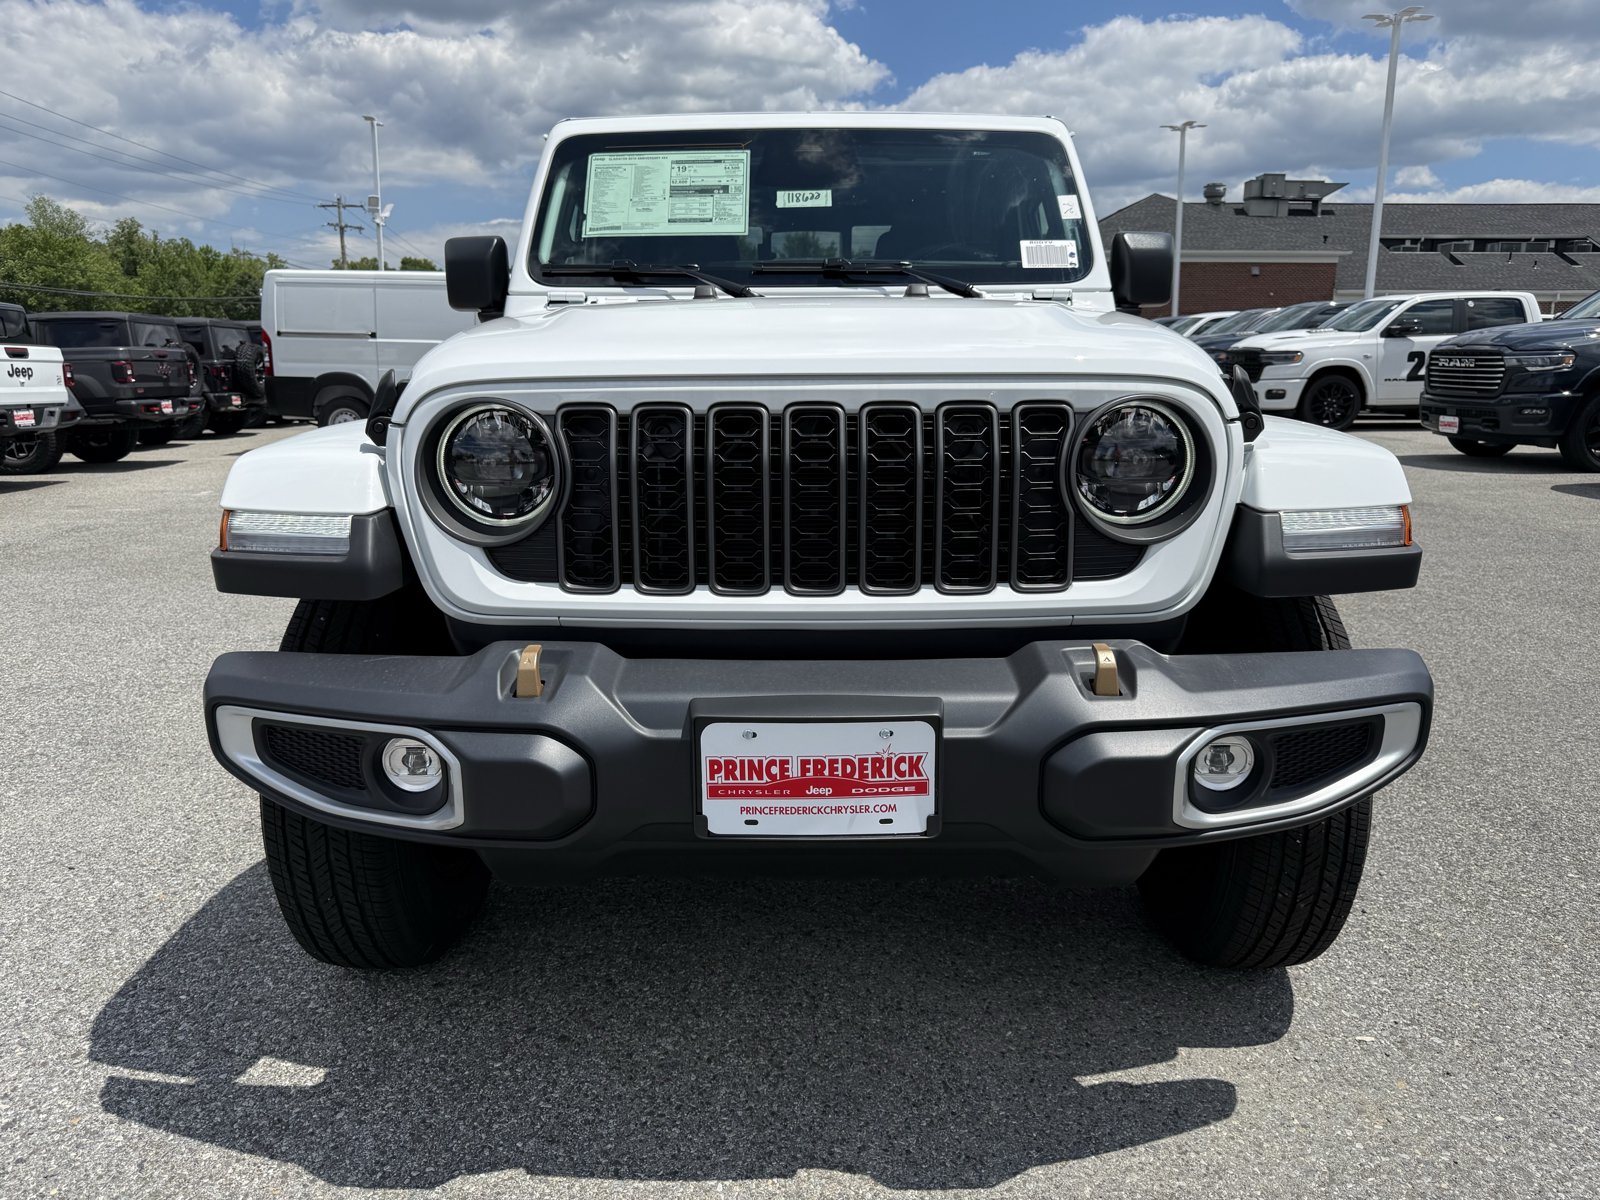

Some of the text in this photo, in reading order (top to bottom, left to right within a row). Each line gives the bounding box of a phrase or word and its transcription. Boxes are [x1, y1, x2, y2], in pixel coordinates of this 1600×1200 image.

[677, 165, 687, 173] 19
[1438, 358, 1476, 367] RAM
[7, 363, 34, 381] Jeep
[706, 754, 926, 783] PRINCE FREDERICK
[805, 785, 833, 796] Jeep
[851, 786, 916, 794] DODGE
[740, 804, 897, 816] PRINCEFREDERICKCHRYSLER.COM
